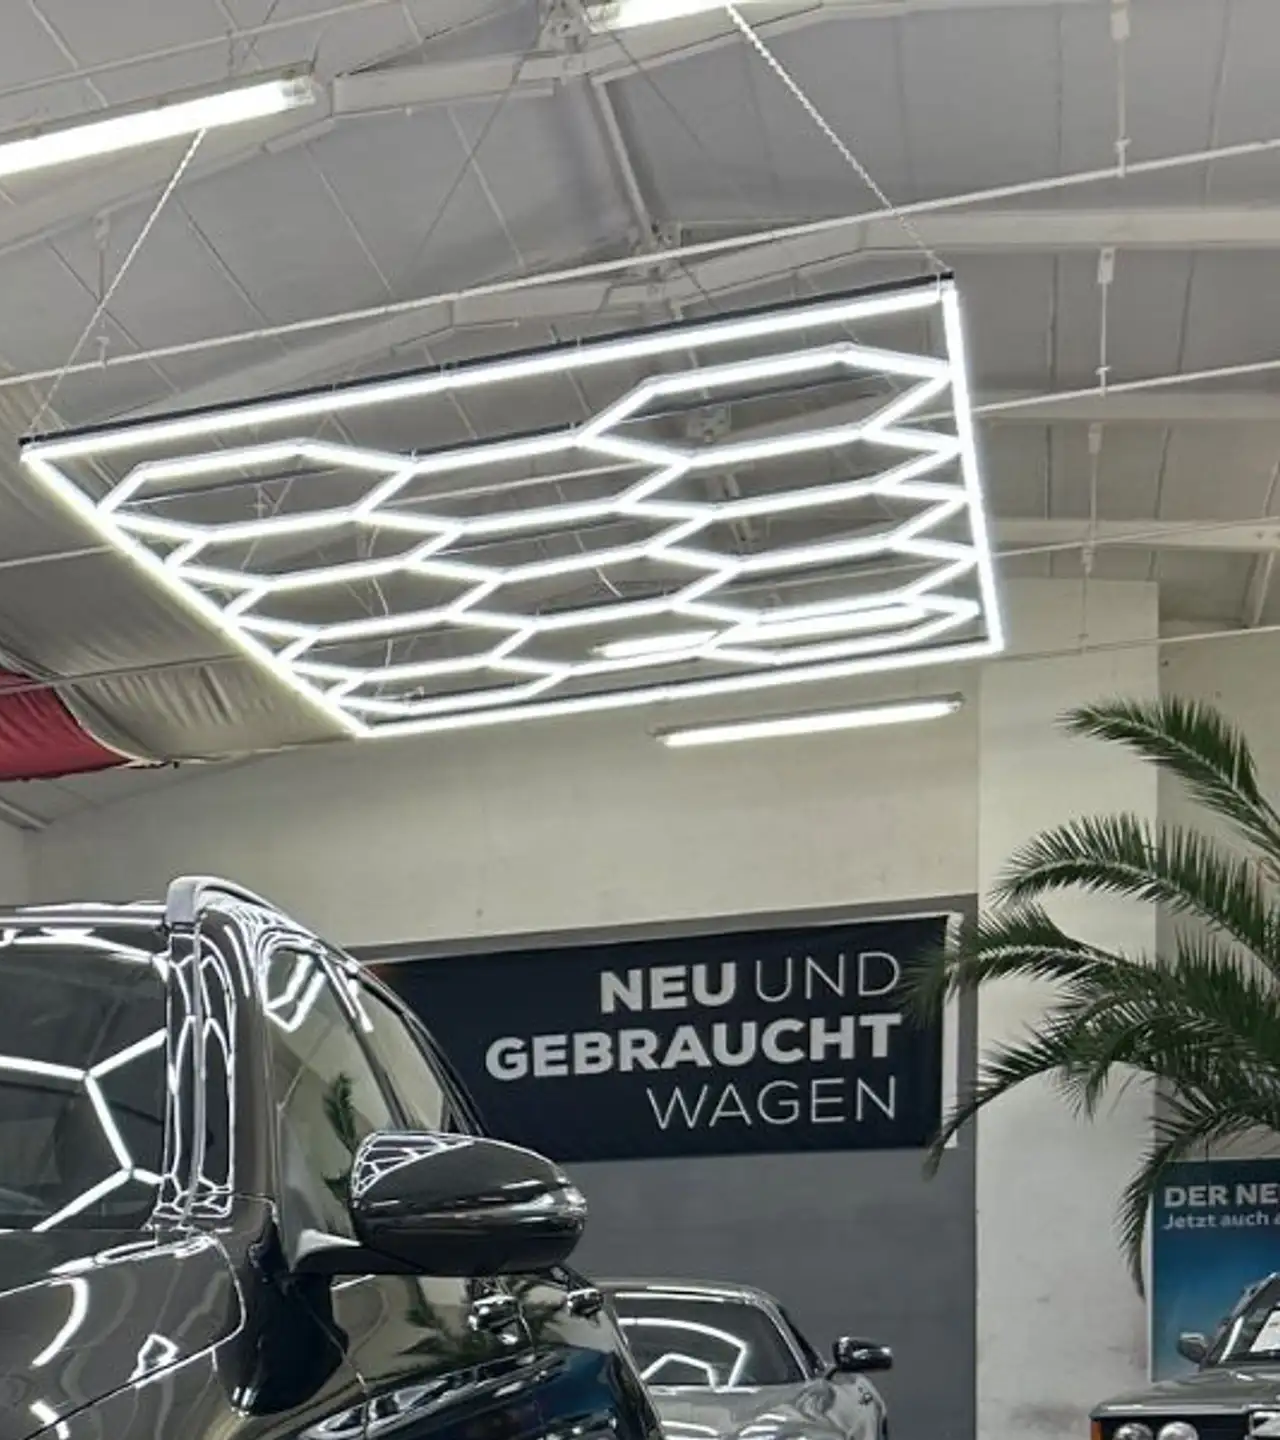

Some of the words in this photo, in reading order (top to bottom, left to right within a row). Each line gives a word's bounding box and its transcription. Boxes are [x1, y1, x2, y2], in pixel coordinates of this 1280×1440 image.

[599, 960, 738, 1015] NEU
[755, 952, 902, 1003] UND
[485, 1013, 902, 1081] GEBRAUCHT
[645, 1075, 897, 1130] WAGEN
[1162, 1213, 1217, 1231] Jetzt
[1220, 1210, 1269, 1227] auch
[1163, 1184, 1229, 1209] DER
